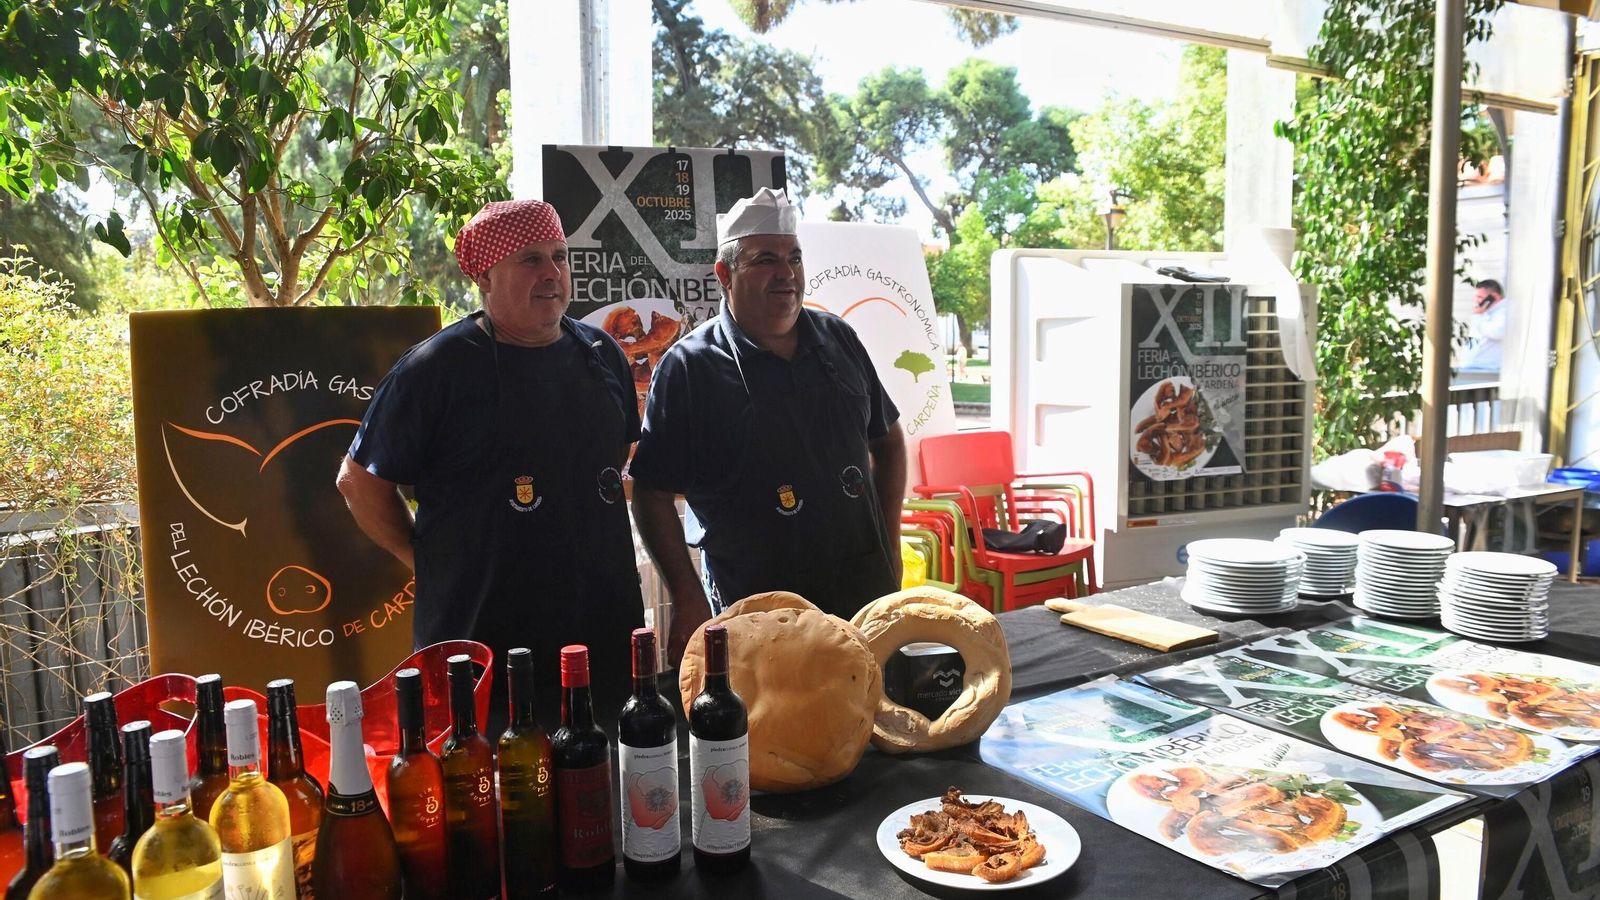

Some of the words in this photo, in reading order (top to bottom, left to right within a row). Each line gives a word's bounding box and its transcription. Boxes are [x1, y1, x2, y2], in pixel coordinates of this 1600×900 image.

[676, 160, 689, 171] 17
[675, 172, 689, 183] 18
[676, 184, 690, 196] 19
[636, 196, 691, 208] OCTUBRE
[664, 209, 692, 221] 2025
[570, 251, 627, 274] ERIA
[674, 272, 721, 302] IBÉ
[867, 268, 940, 351] GASTRONÓMICA
[1138, 349, 1170, 363] FERIA
[206, 370, 318, 425] COFRADÍA
[328, 375, 375, 400] GAS
[906, 384, 942, 436] CARDEÑA
[170, 522, 187, 550] DEL
[170, 550, 243, 628] LECHÓN
[242, 619, 335, 648] IBÉRICO
[342, 619, 366, 638] DE
[1239, 697, 1301, 717] FERIA
[230, 753, 255, 761] Robles
